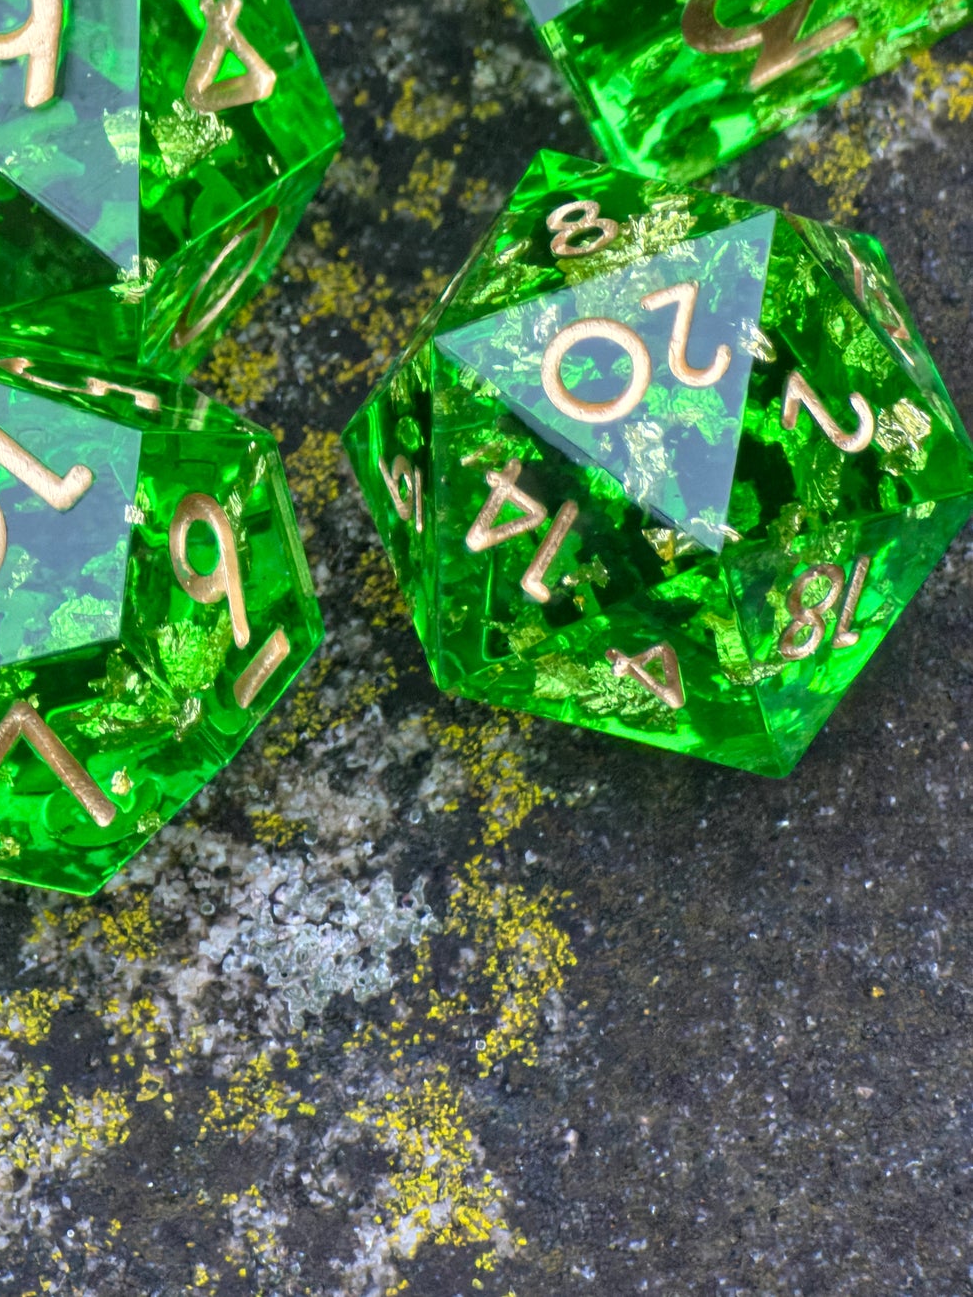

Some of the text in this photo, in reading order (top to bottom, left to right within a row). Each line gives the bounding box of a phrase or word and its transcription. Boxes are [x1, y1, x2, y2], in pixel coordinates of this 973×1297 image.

[545, 200, 619, 258] 8
[540, 281, 733, 424] 20
[782, 371, 875, 454] 2
[465, 459, 579, 603] 14
[778, 555, 872, 661] 18
[604, 641, 686, 710] 4
